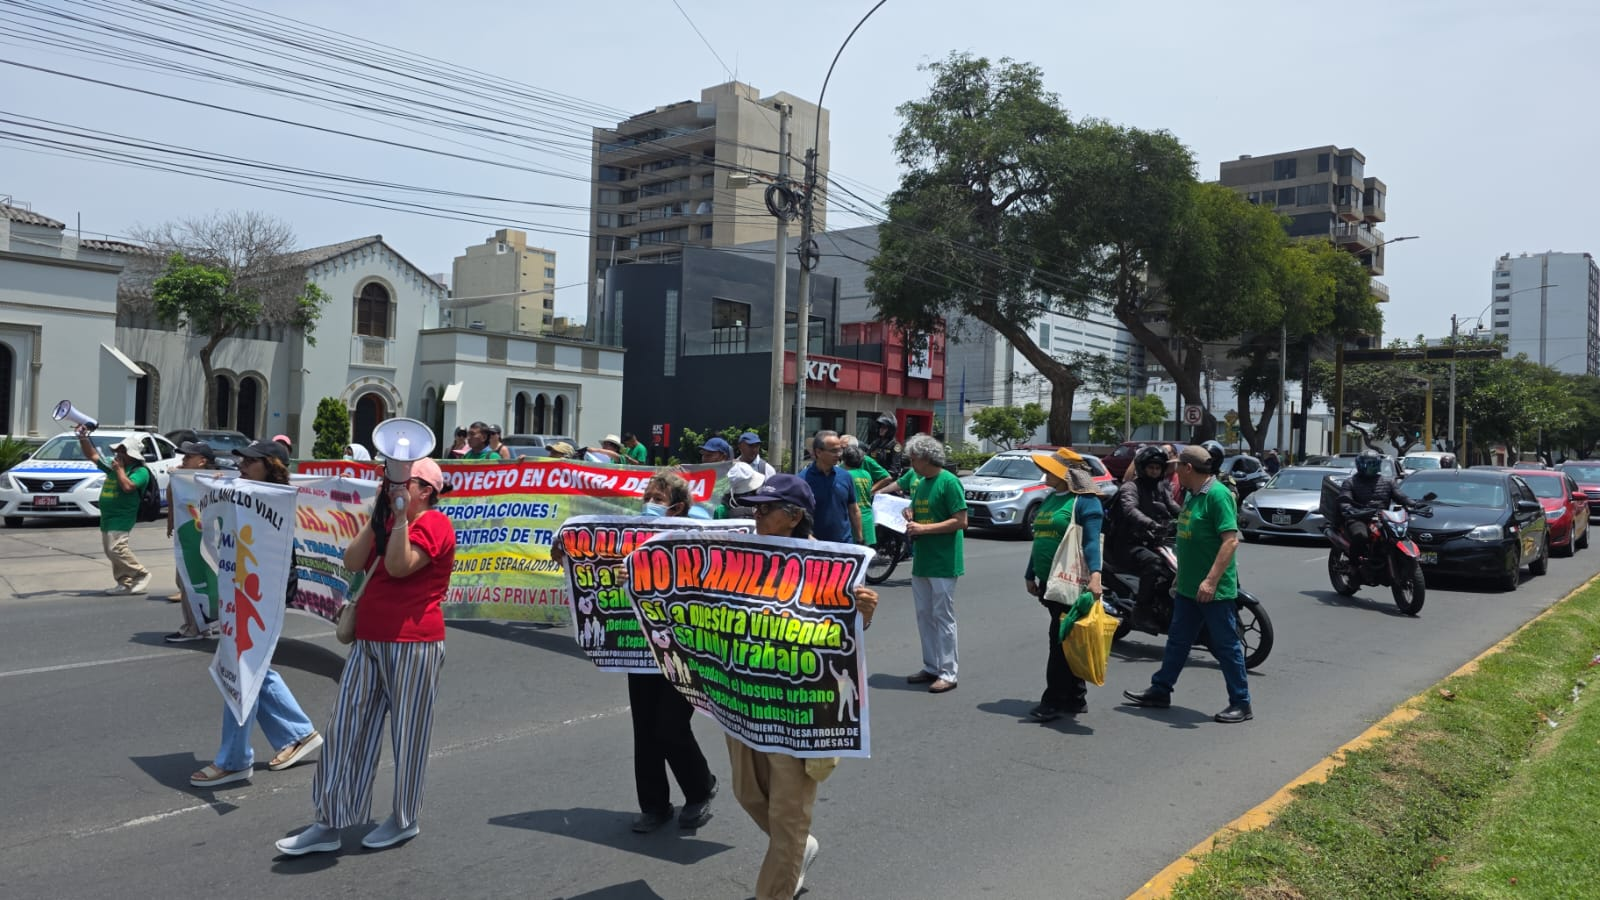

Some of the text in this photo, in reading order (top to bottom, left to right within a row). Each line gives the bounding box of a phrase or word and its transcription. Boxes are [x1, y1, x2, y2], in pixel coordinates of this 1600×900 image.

[805, 360, 842, 382] KFC
[520, 468, 545, 487] EN
[547, 468, 618, 489] CONTRA
[209, 489, 219, 504] AL
[218, 487, 252, 509] ANILLO
[255, 498, 283, 531] VIAL!
[434, 502, 549, 519] XPROPIACIONES
[455, 527, 553, 545] ENTROS DE TR
[562, 530, 595, 558] NO
[304, 539, 347, 560] TRABAJ
[218, 559, 237, 572] asa
[452, 556, 561, 573] BANO DE SEPARADORA
[598, 568, 613, 588] a
[632, 548, 671, 592] NO
[676, 547, 702, 588] AL
[702, 548, 801, 602] ANILLO
[799, 558, 853, 607] VIAL
[467, 583, 502, 603] VÍAS
[671, 605, 687, 624] a
[688, 603, 747, 635] nuestra
[732, 638, 817, 676] trabajo
[741, 680, 784, 700] bosque
[786, 687, 835, 703] urbano
[751, 702, 814, 725] Industrial
[791, 727, 845, 738] DESARROLLO
[846, 727, 859, 736] DE
[814, 737, 854, 748] ADESASI
